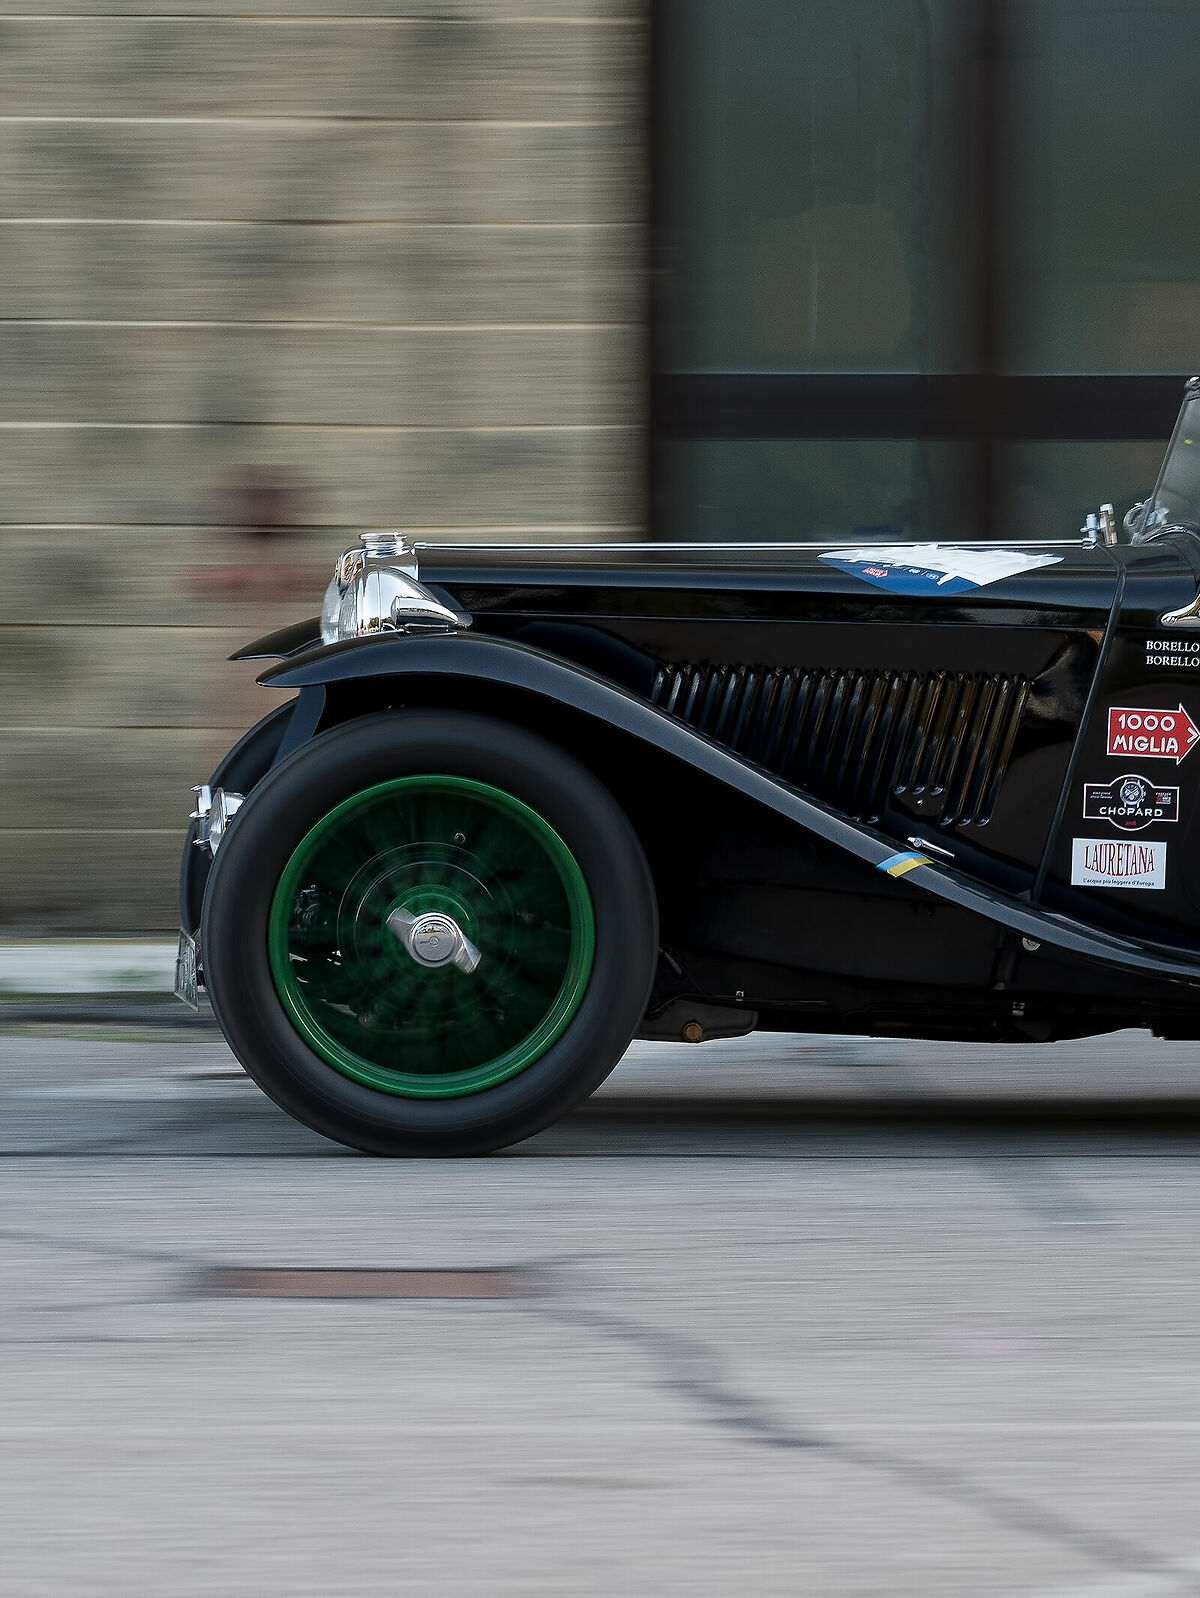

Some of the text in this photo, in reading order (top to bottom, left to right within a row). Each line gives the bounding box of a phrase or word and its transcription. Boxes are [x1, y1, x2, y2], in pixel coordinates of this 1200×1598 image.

[1146, 640, 1200, 653] BORELLO
[1146, 655, 1200, 667] BORELLO
[1118, 713, 1175, 732] 1000
[1113, 734, 1179, 754] MIGLIA
[1099, 806, 1163, 817] CHOPARD
[1084, 843, 1155, 877] LAURETANA
